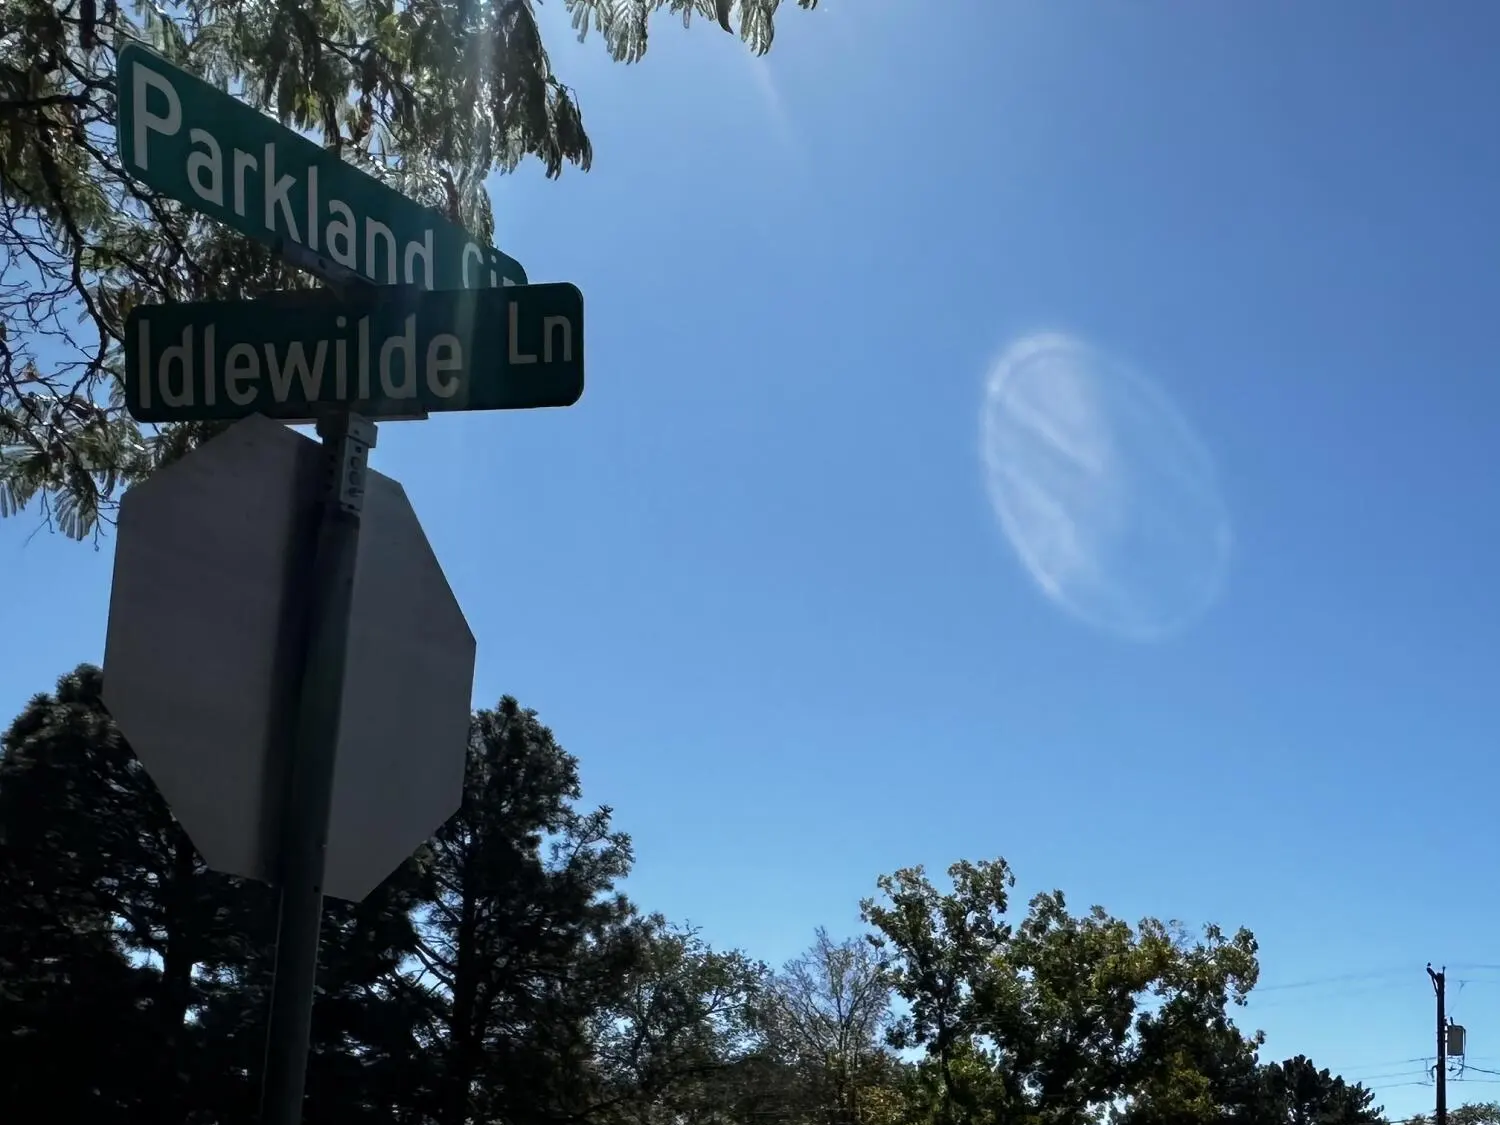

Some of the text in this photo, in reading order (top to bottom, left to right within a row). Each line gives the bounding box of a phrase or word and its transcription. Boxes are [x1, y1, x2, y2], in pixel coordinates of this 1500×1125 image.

[132, 62, 516, 291] Parkland Ci
[138, 301, 573, 410] Idlewilde Ln
